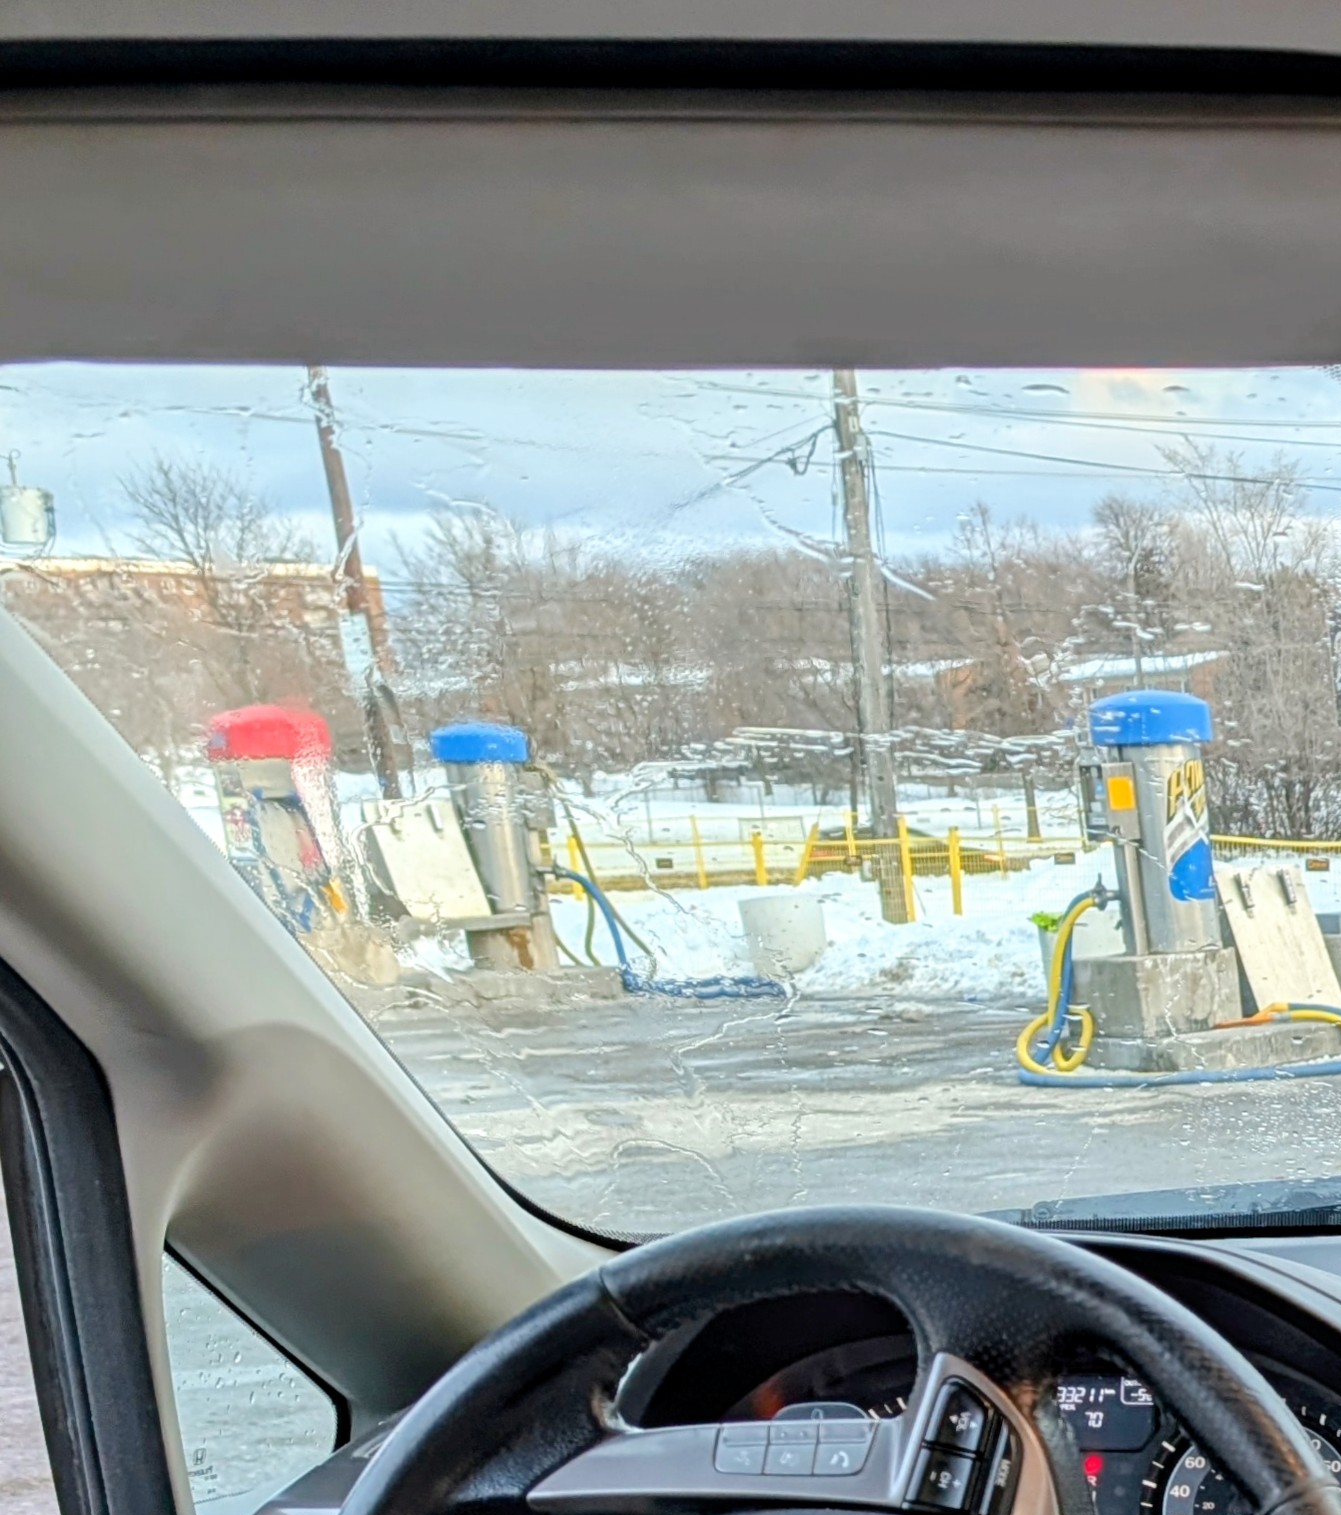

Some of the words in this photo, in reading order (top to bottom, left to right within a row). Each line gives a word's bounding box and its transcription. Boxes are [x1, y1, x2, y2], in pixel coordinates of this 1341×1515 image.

[1184, 1456, 1206, 1469] 60
[1169, 1484, 1191, 1498] 40
[1202, 1502, 1216, 1510] 20
